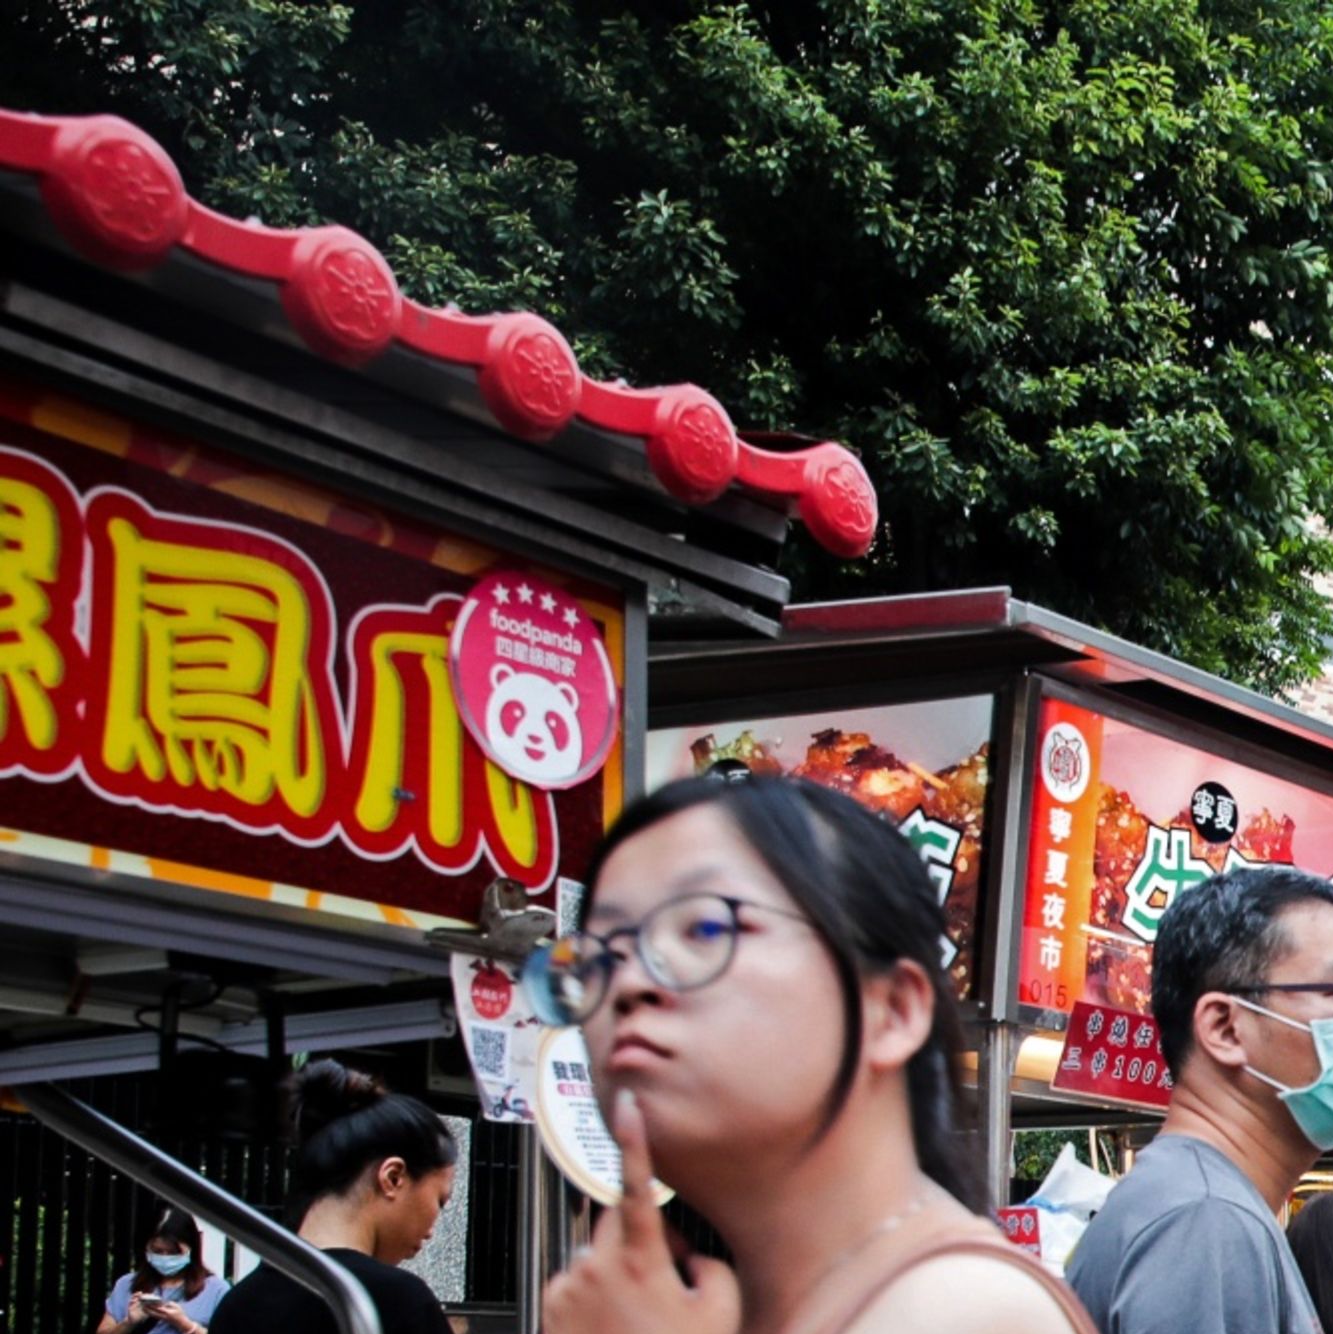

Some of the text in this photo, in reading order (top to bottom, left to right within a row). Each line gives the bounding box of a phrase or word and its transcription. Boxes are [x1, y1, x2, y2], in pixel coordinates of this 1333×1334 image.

[490, 608, 583, 655] foodpanda
[1193, 788, 1236, 832] 寧夏
[1040, 806, 1073, 970] 寧夏夜市
[1029, 979, 1068, 1008] 015
[1087, 1009, 1162, 1054] 串燒任
